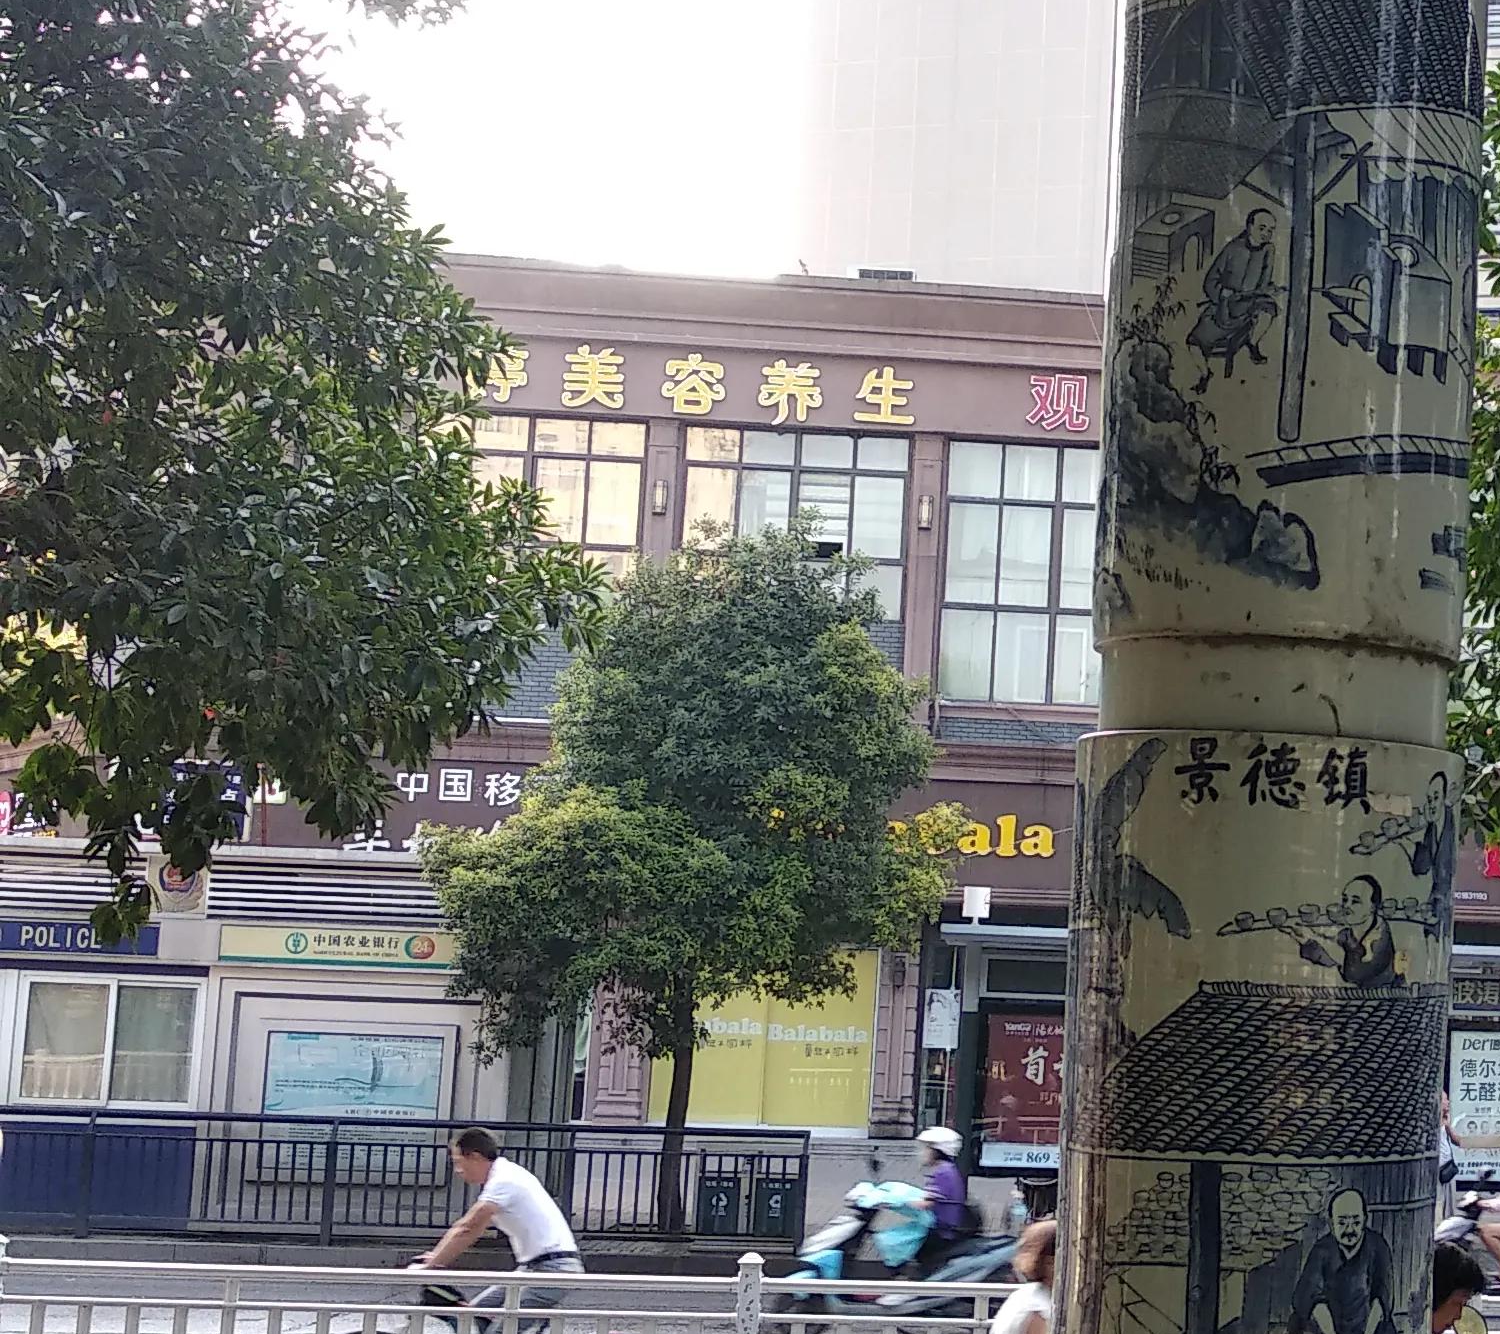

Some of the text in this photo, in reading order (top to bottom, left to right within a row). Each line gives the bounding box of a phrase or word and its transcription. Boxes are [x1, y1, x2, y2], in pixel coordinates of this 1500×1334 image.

[312, 932, 400, 951] 中国农业银行
[767, 1023, 869, 1044] Balabala
